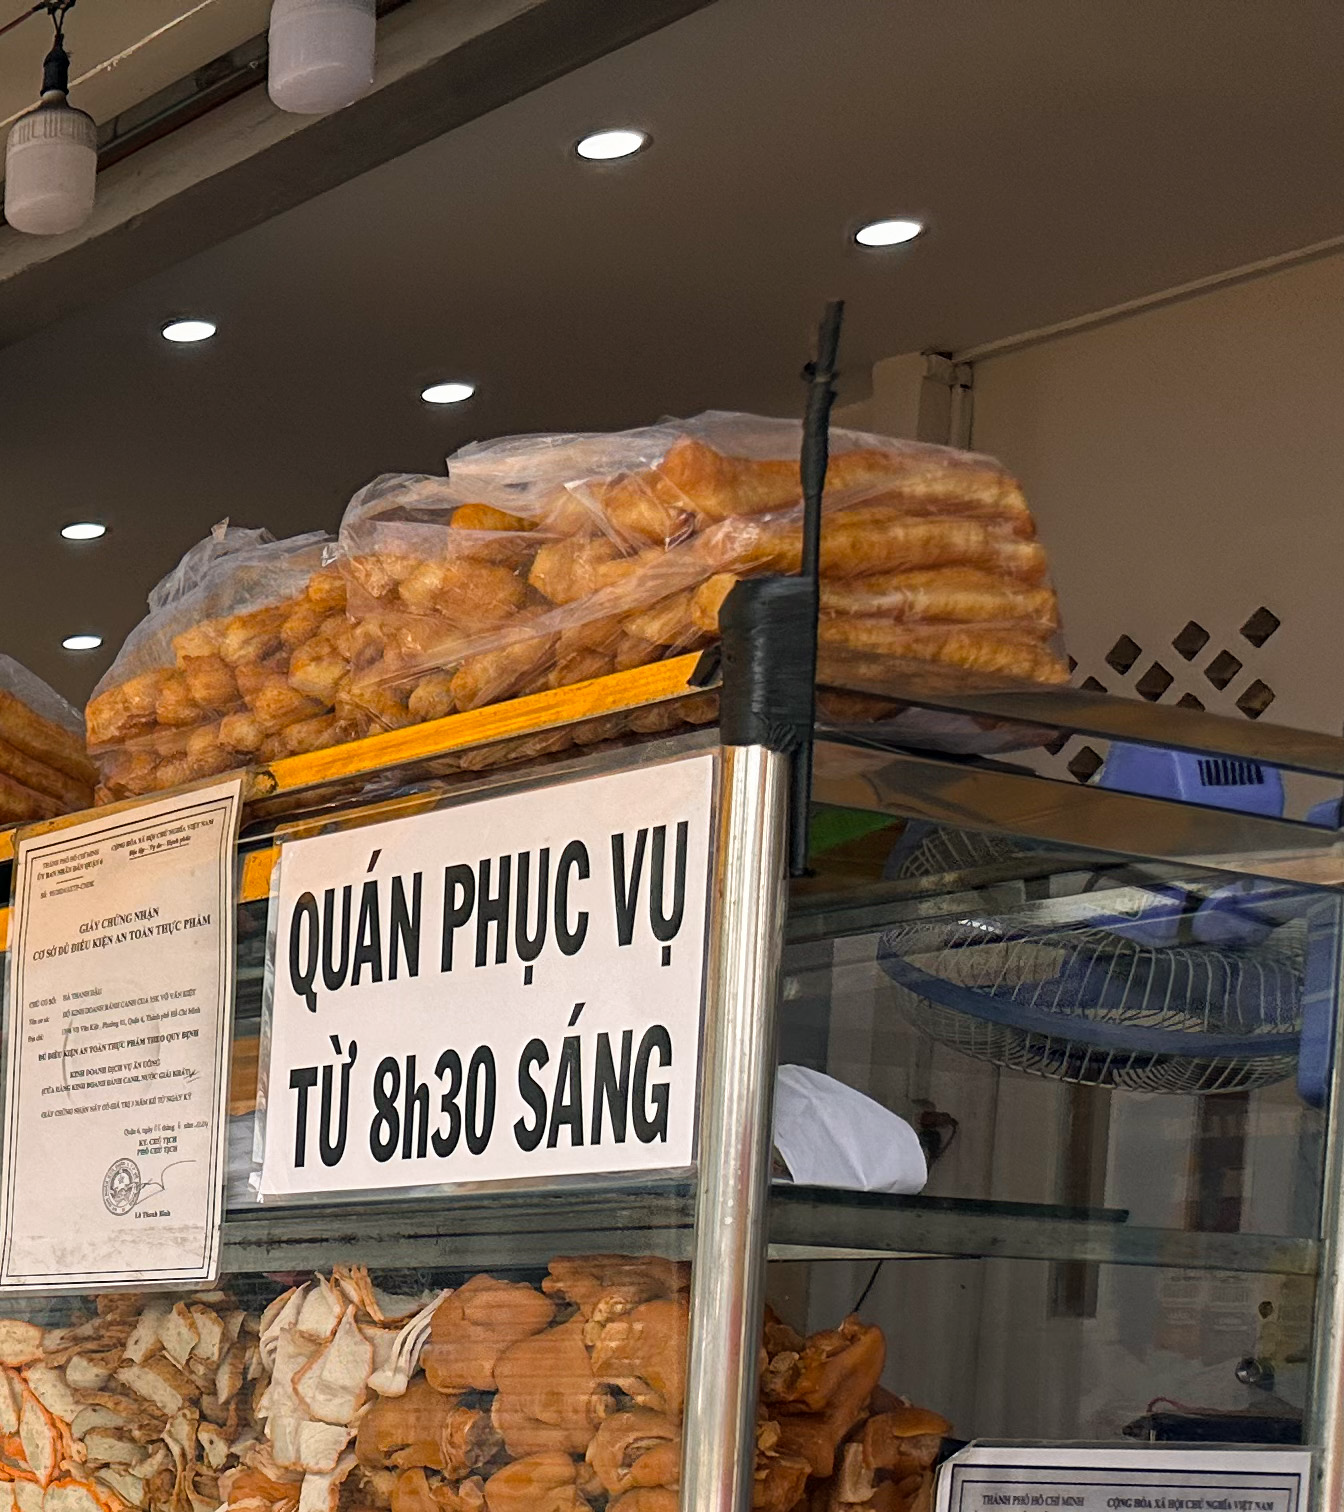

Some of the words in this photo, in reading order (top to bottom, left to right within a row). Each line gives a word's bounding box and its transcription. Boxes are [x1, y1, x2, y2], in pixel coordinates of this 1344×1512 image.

[289, 847, 422, 1013] QUÁN
[440, 840, 591, 970] PHỤC
[612, 820, 689, 967] VỤ
[288, 1038, 358, 1168] TỪ
[369, 1044, 497, 1163] 8h30
[513, 1002, 673, 1152] SÁNG
